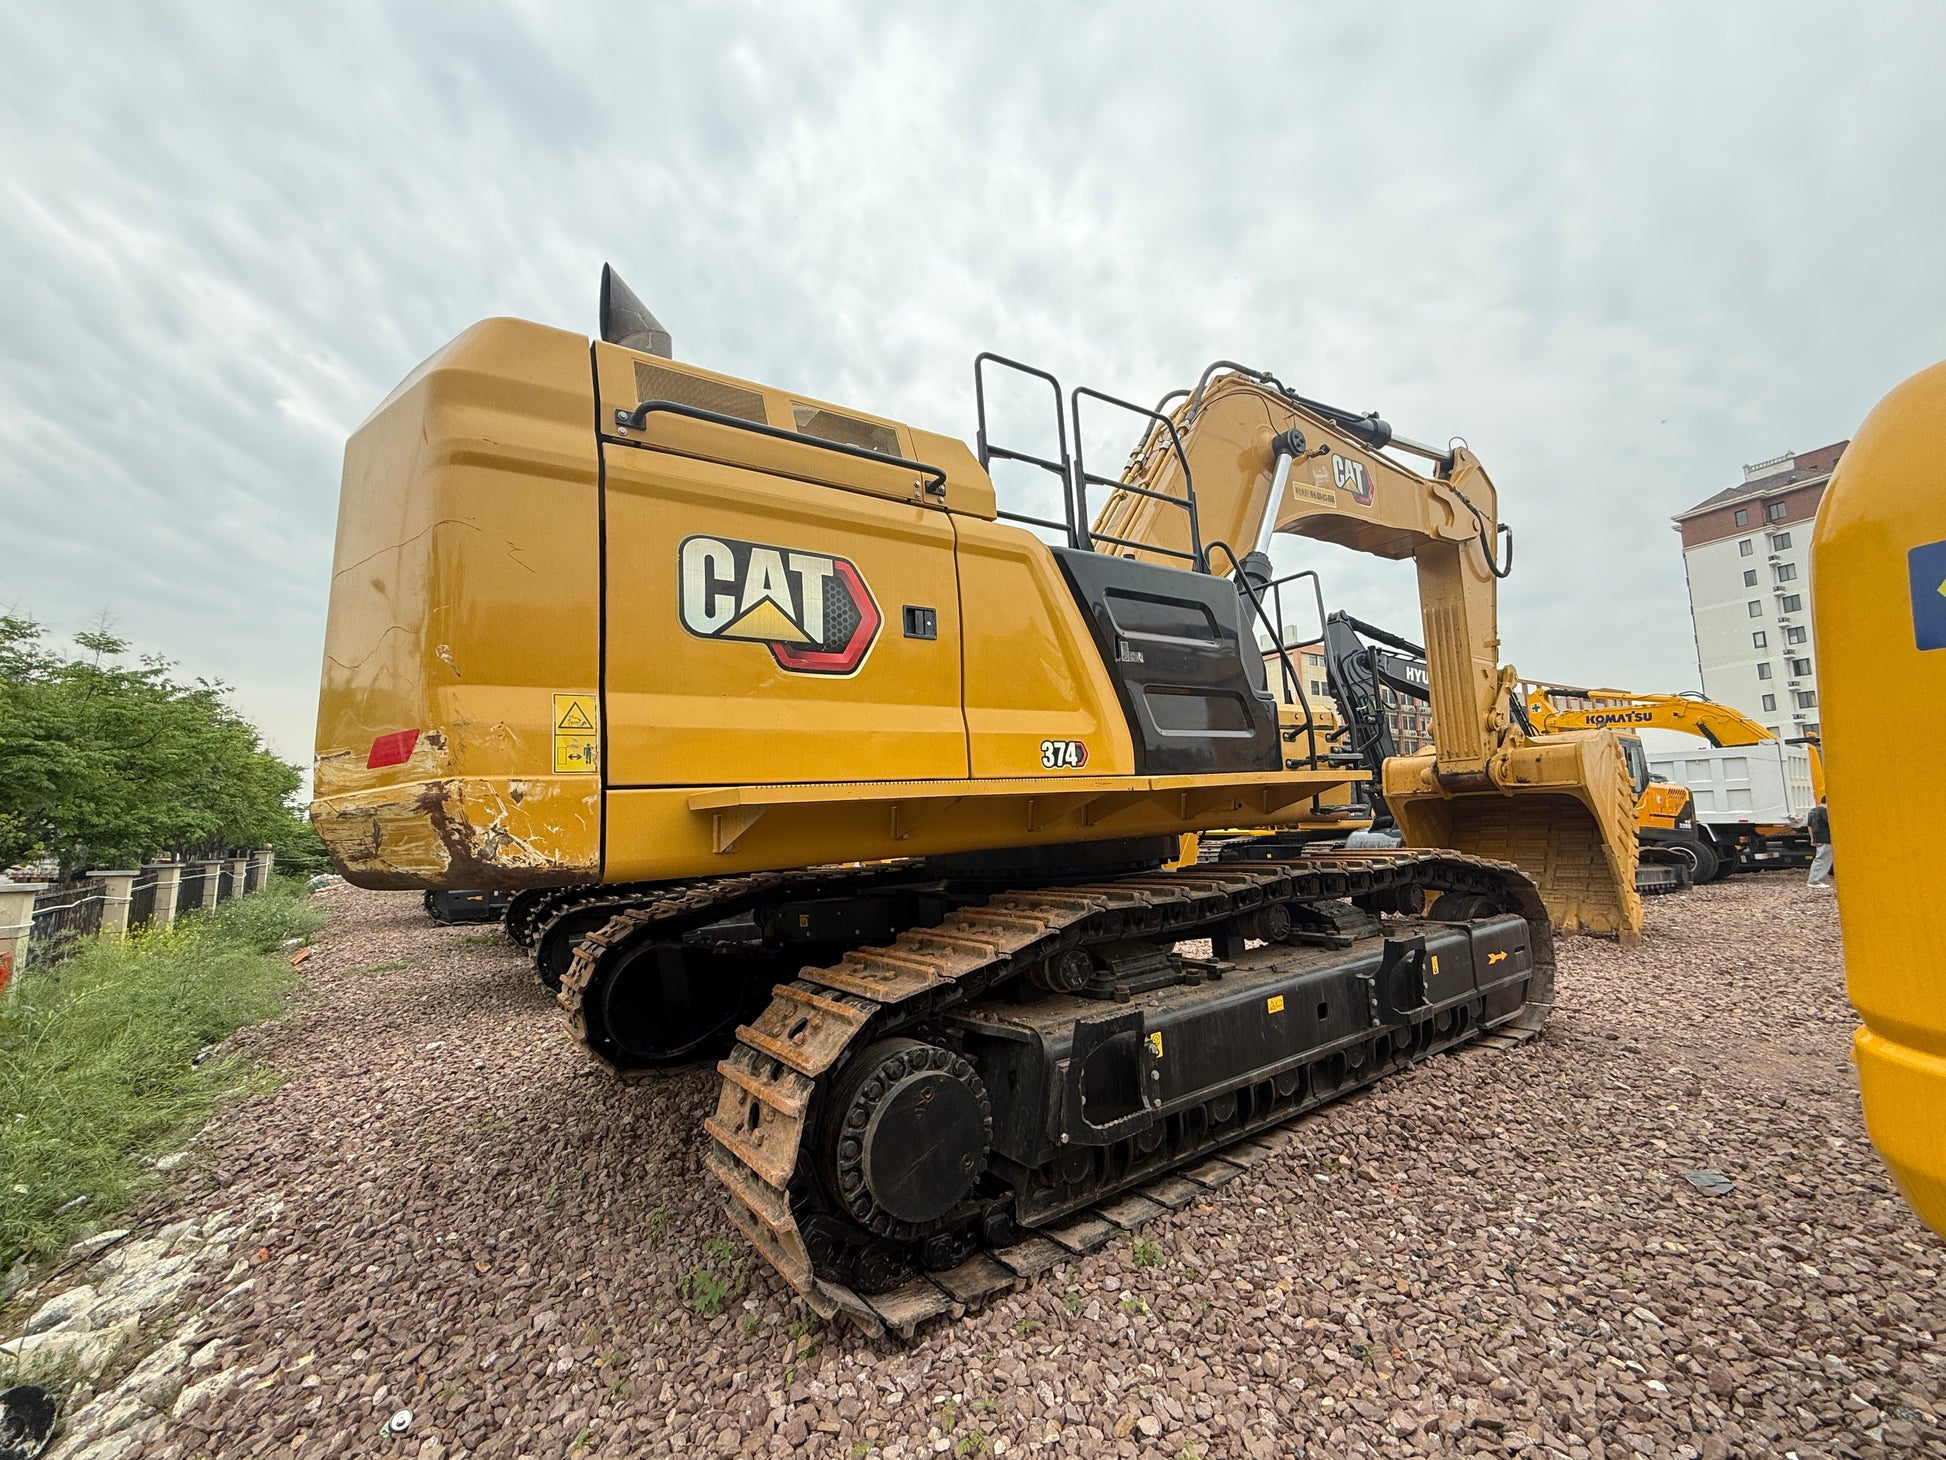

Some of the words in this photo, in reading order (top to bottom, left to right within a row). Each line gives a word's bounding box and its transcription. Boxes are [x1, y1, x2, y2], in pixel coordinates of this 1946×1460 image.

[1332, 454, 1363, 495] CAT
[683, 538, 834, 644] CAT
[1585, 710, 1653, 725] KOMATSU
[1041, 741, 1078, 767] 374
